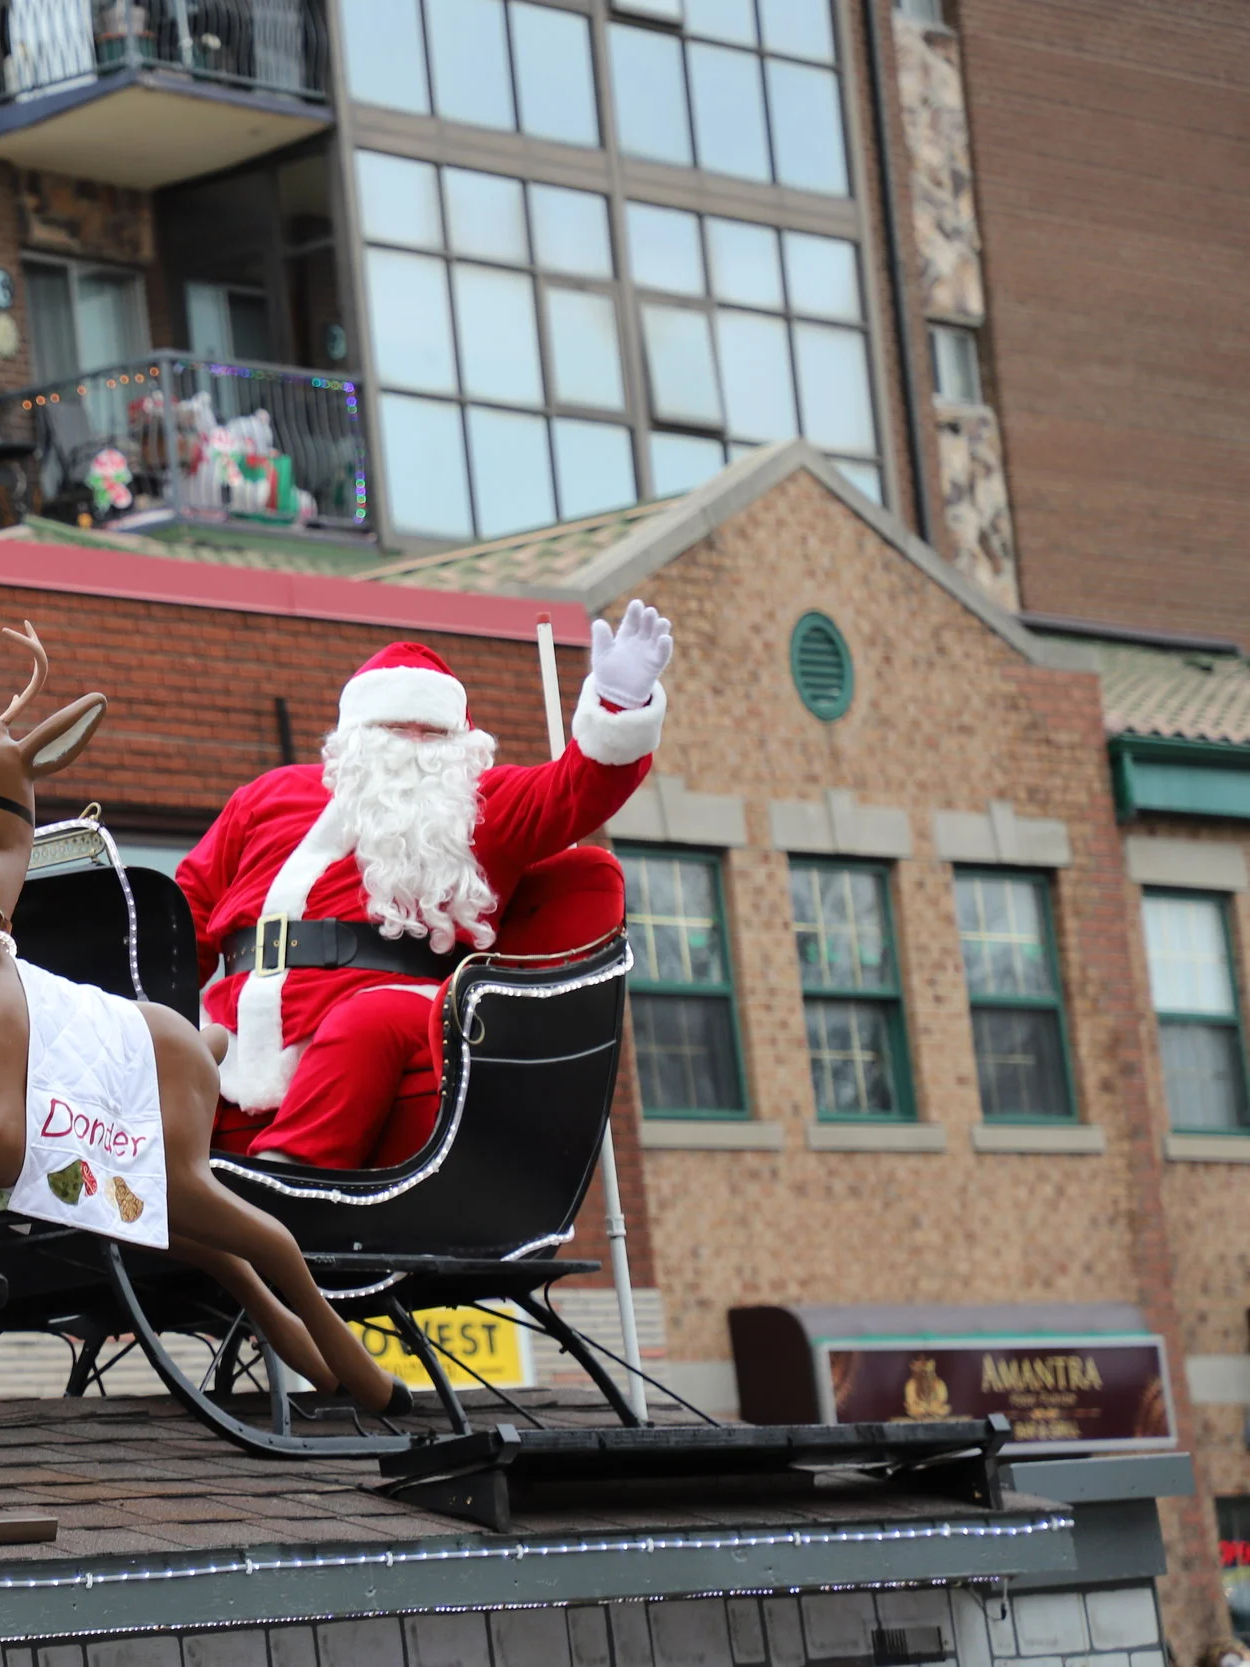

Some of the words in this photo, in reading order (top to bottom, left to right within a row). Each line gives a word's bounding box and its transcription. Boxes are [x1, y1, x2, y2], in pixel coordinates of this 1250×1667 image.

[40, 1097, 147, 1157] Donder
[361, 1318, 499, 1358] OEST
[980, 1352, 1104, 1394] AMANTRA
